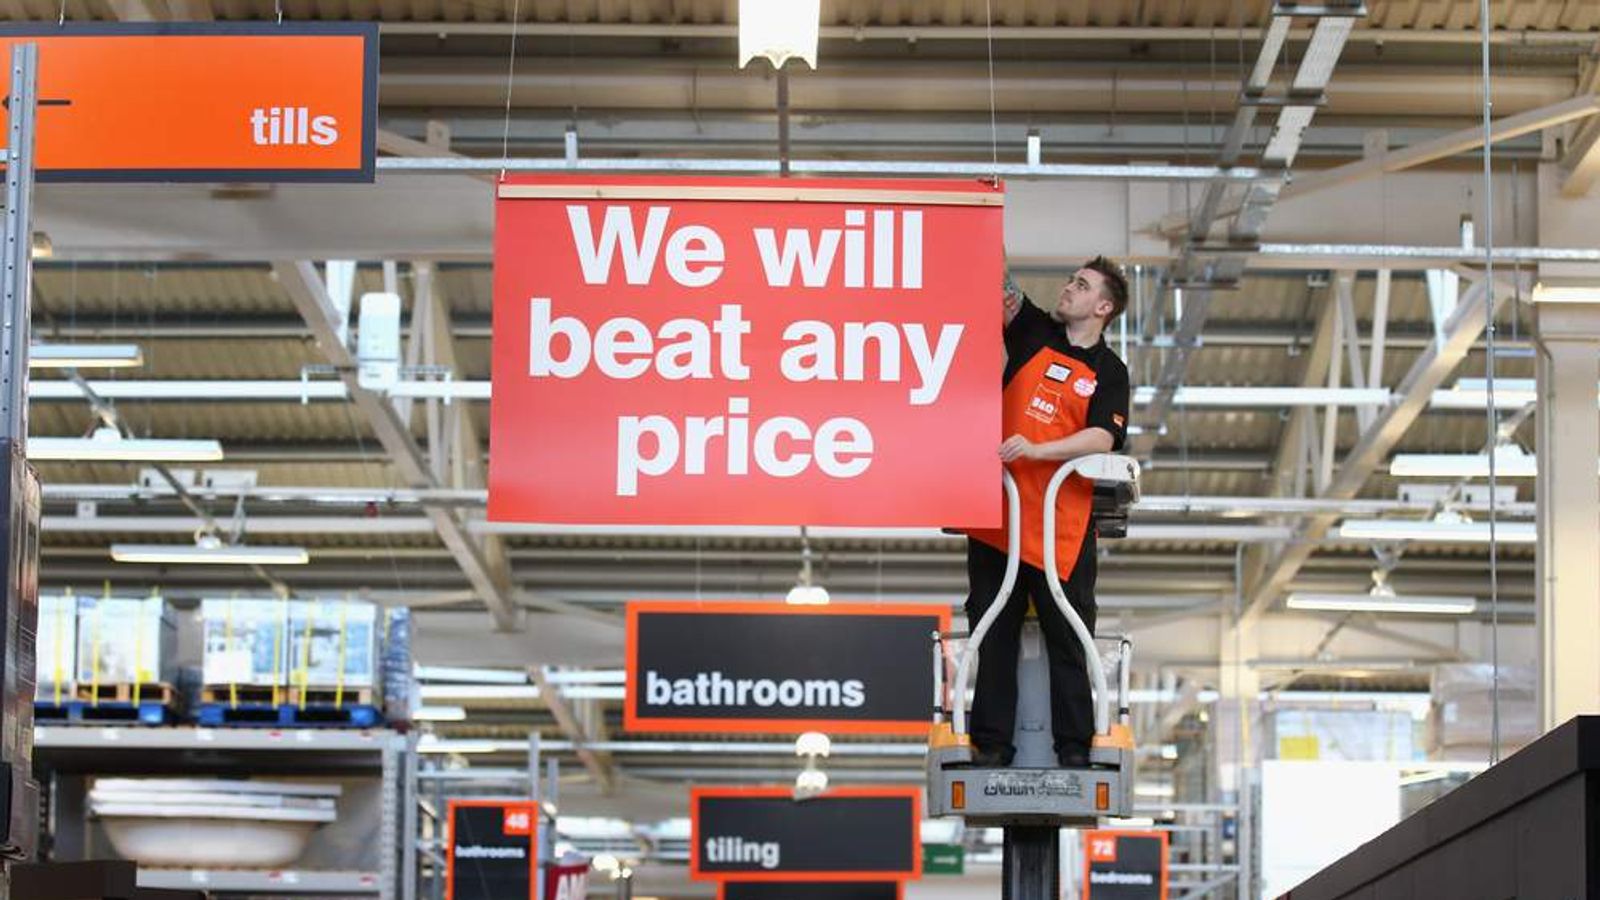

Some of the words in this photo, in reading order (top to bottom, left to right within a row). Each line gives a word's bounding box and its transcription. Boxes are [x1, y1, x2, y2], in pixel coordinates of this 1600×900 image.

[250, 107, 338, 146] tills
[566, 205, 725, 288] We
[753, 209, 923, 289] will
[529, 297, 751, 381] beat
[780, 320, 965, 406] any
[616, 397, 875, 497] price
[646, 671, 865, 708] bathrooms
[454, 845, 525, 859] bathrooms
[705, 836, 780, 869] tiling
[1090, 871, 1153, 885] bedrooms
